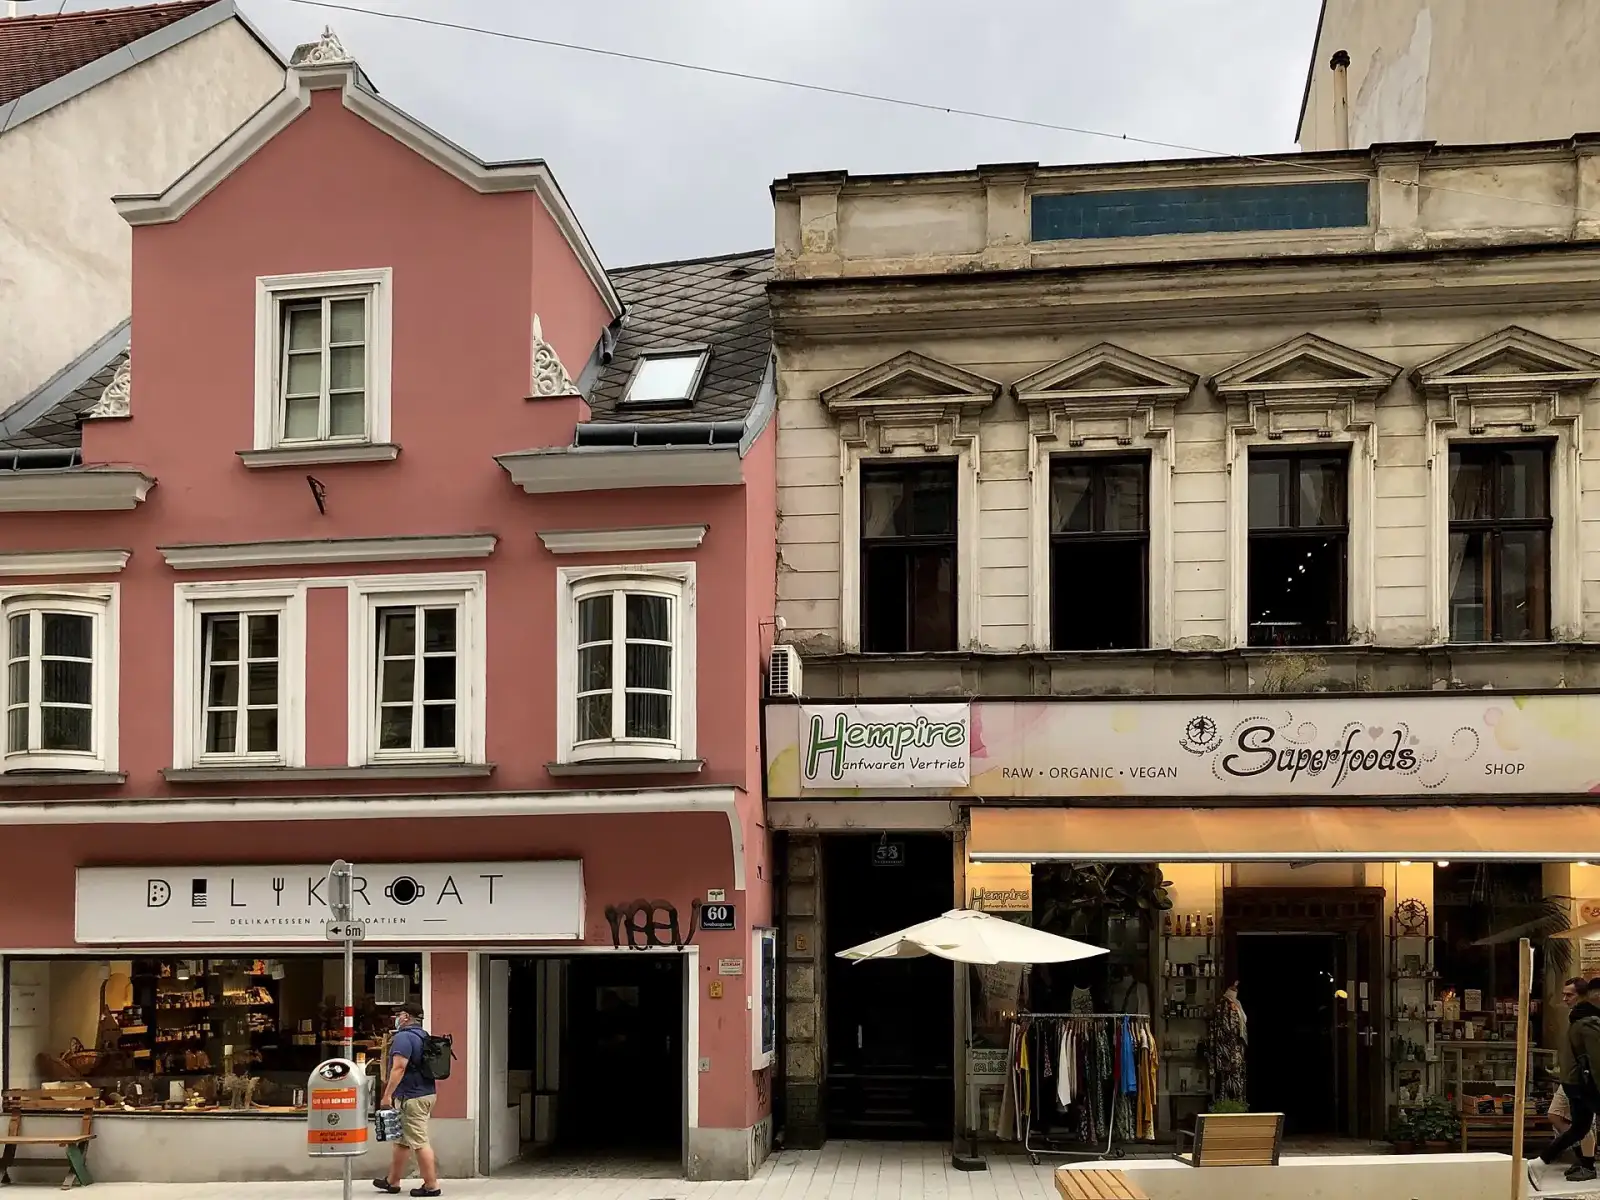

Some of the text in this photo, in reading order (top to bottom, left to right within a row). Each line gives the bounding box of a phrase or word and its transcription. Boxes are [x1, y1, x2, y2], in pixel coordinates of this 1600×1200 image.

[805, 713, 965, 780] Hempire
[1179, 739, 1204, 757] Dancing
[910, 757, 965, 769] Vertrieb
[1222, 725, 1417, 789] Superfoods
[1002, 766, 1178, 779] RAW ORGANIC VEGAN
[1484, 763, 1525, 775] SHOP
[707, 906, 728, 920] 60
[345, 925, 361, 937] 6m
